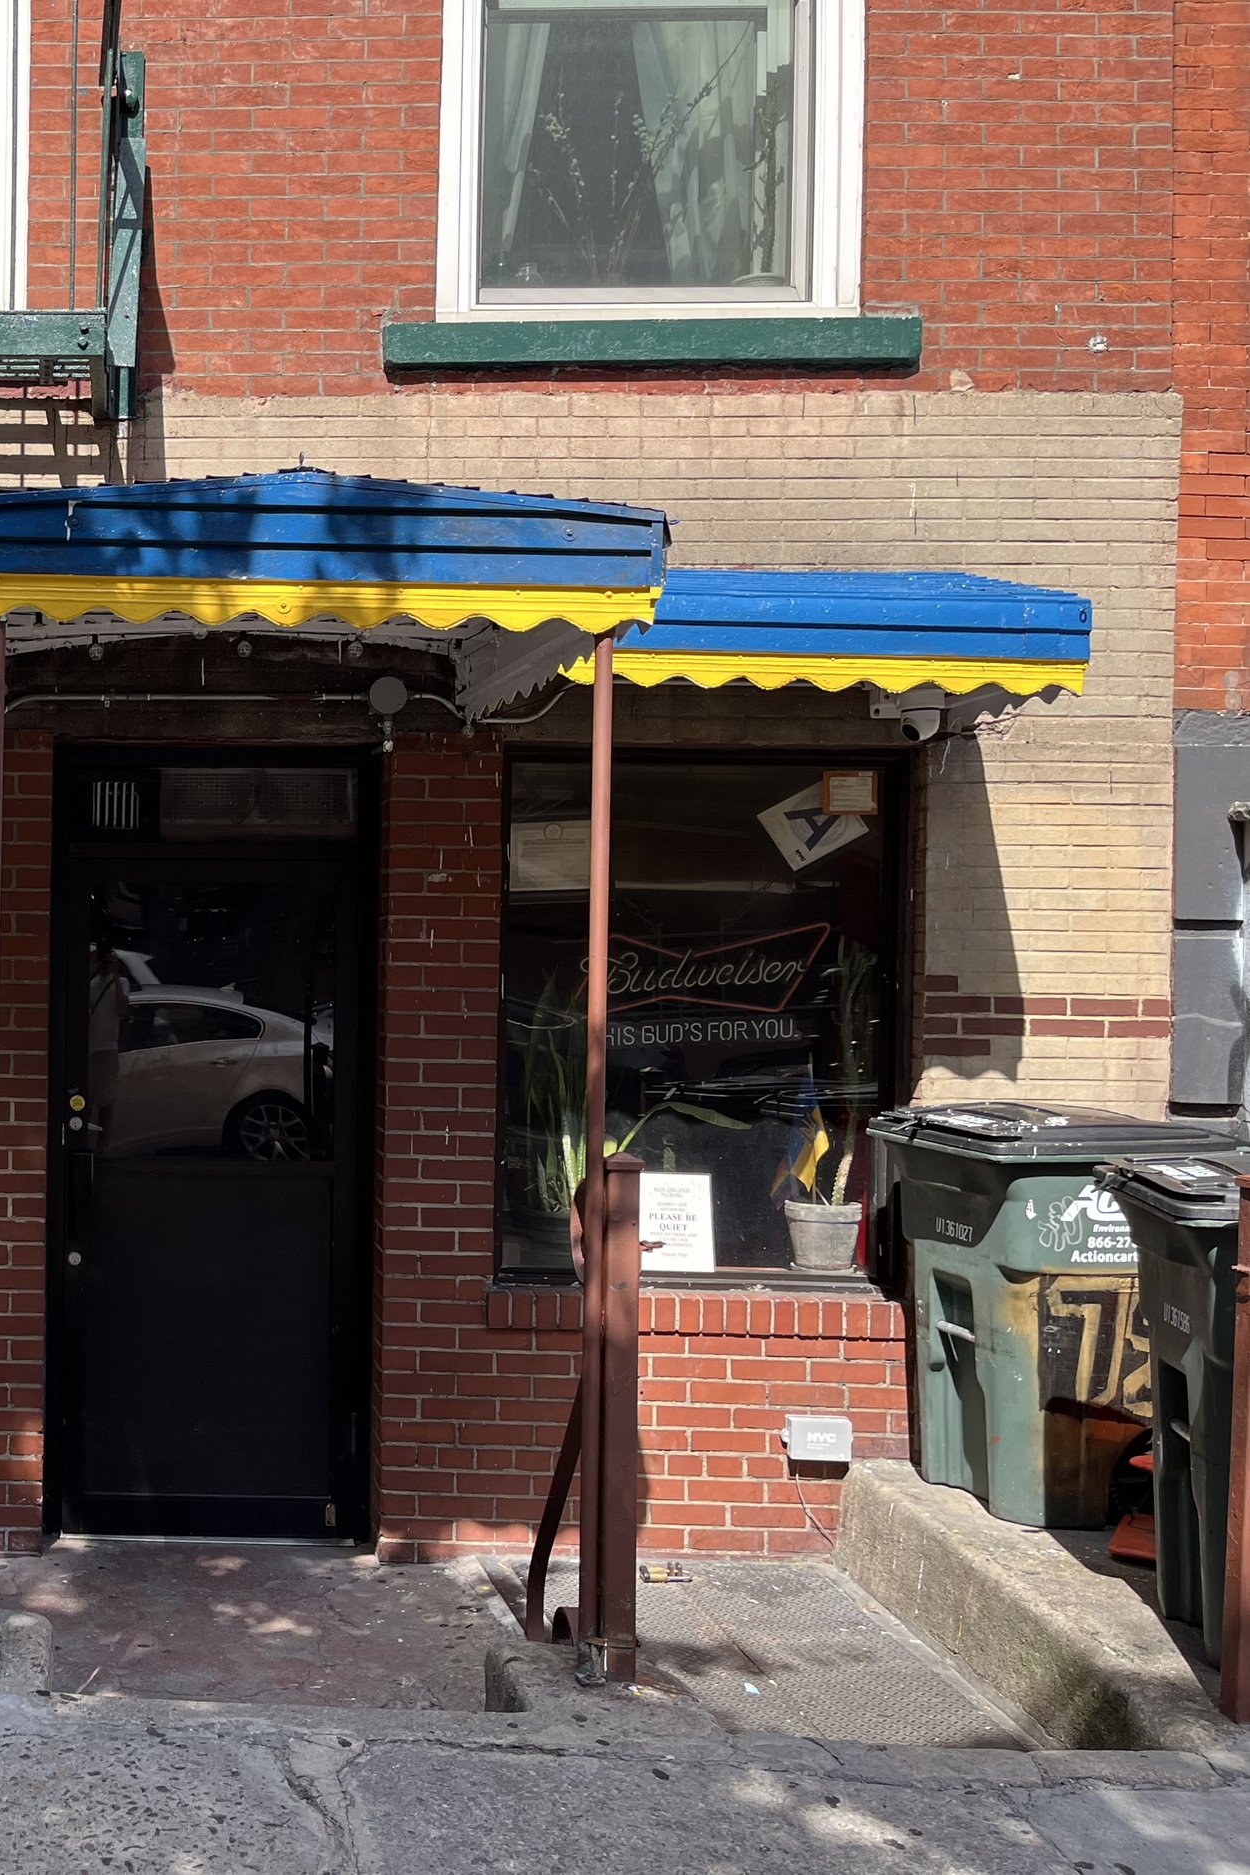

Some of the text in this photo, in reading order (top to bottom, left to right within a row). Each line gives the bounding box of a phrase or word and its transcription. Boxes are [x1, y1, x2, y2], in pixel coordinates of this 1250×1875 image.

[580, 949, 808, 994] Budweiser
[606, 1026, 636, 1047] HIS
[642, 1022, 703, 1045] BUD'S
[707, 1020, 749, 1042] FOR
[649, 1212, 698, 1222] PLEASE BE
[659, 1223, 688, 1232] QUIET
[935, 1216, 974, 1243] U1361027
[1087, 1236, 1138, 1249] 866-27
[1070, 1250, 1140, 1263] Actioncart
[806, 1431, 837, 1443] NYC
